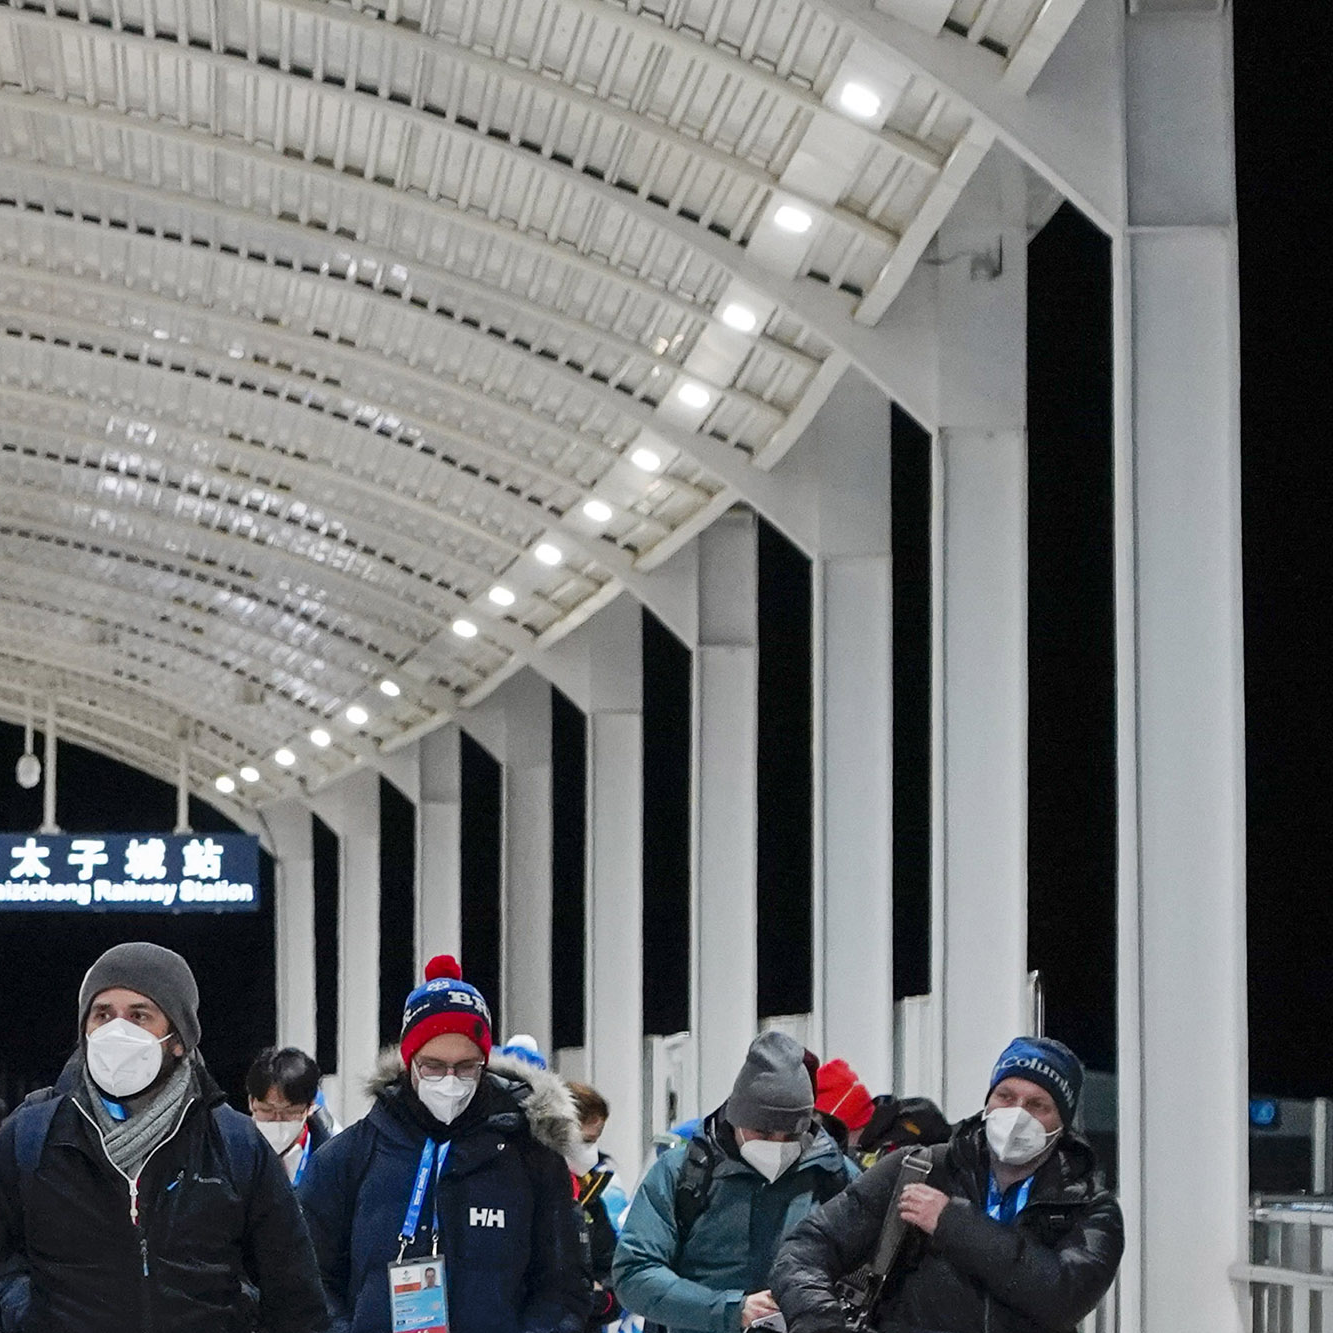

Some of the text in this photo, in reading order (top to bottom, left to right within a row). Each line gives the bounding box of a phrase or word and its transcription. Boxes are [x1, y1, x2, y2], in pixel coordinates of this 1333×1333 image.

[9, 837, 224, 881] 太子城站
[93, 878, 178, 906] Railway
[179, 879, 254, 903] Station
[469, 1207, 506, 1229] HH
